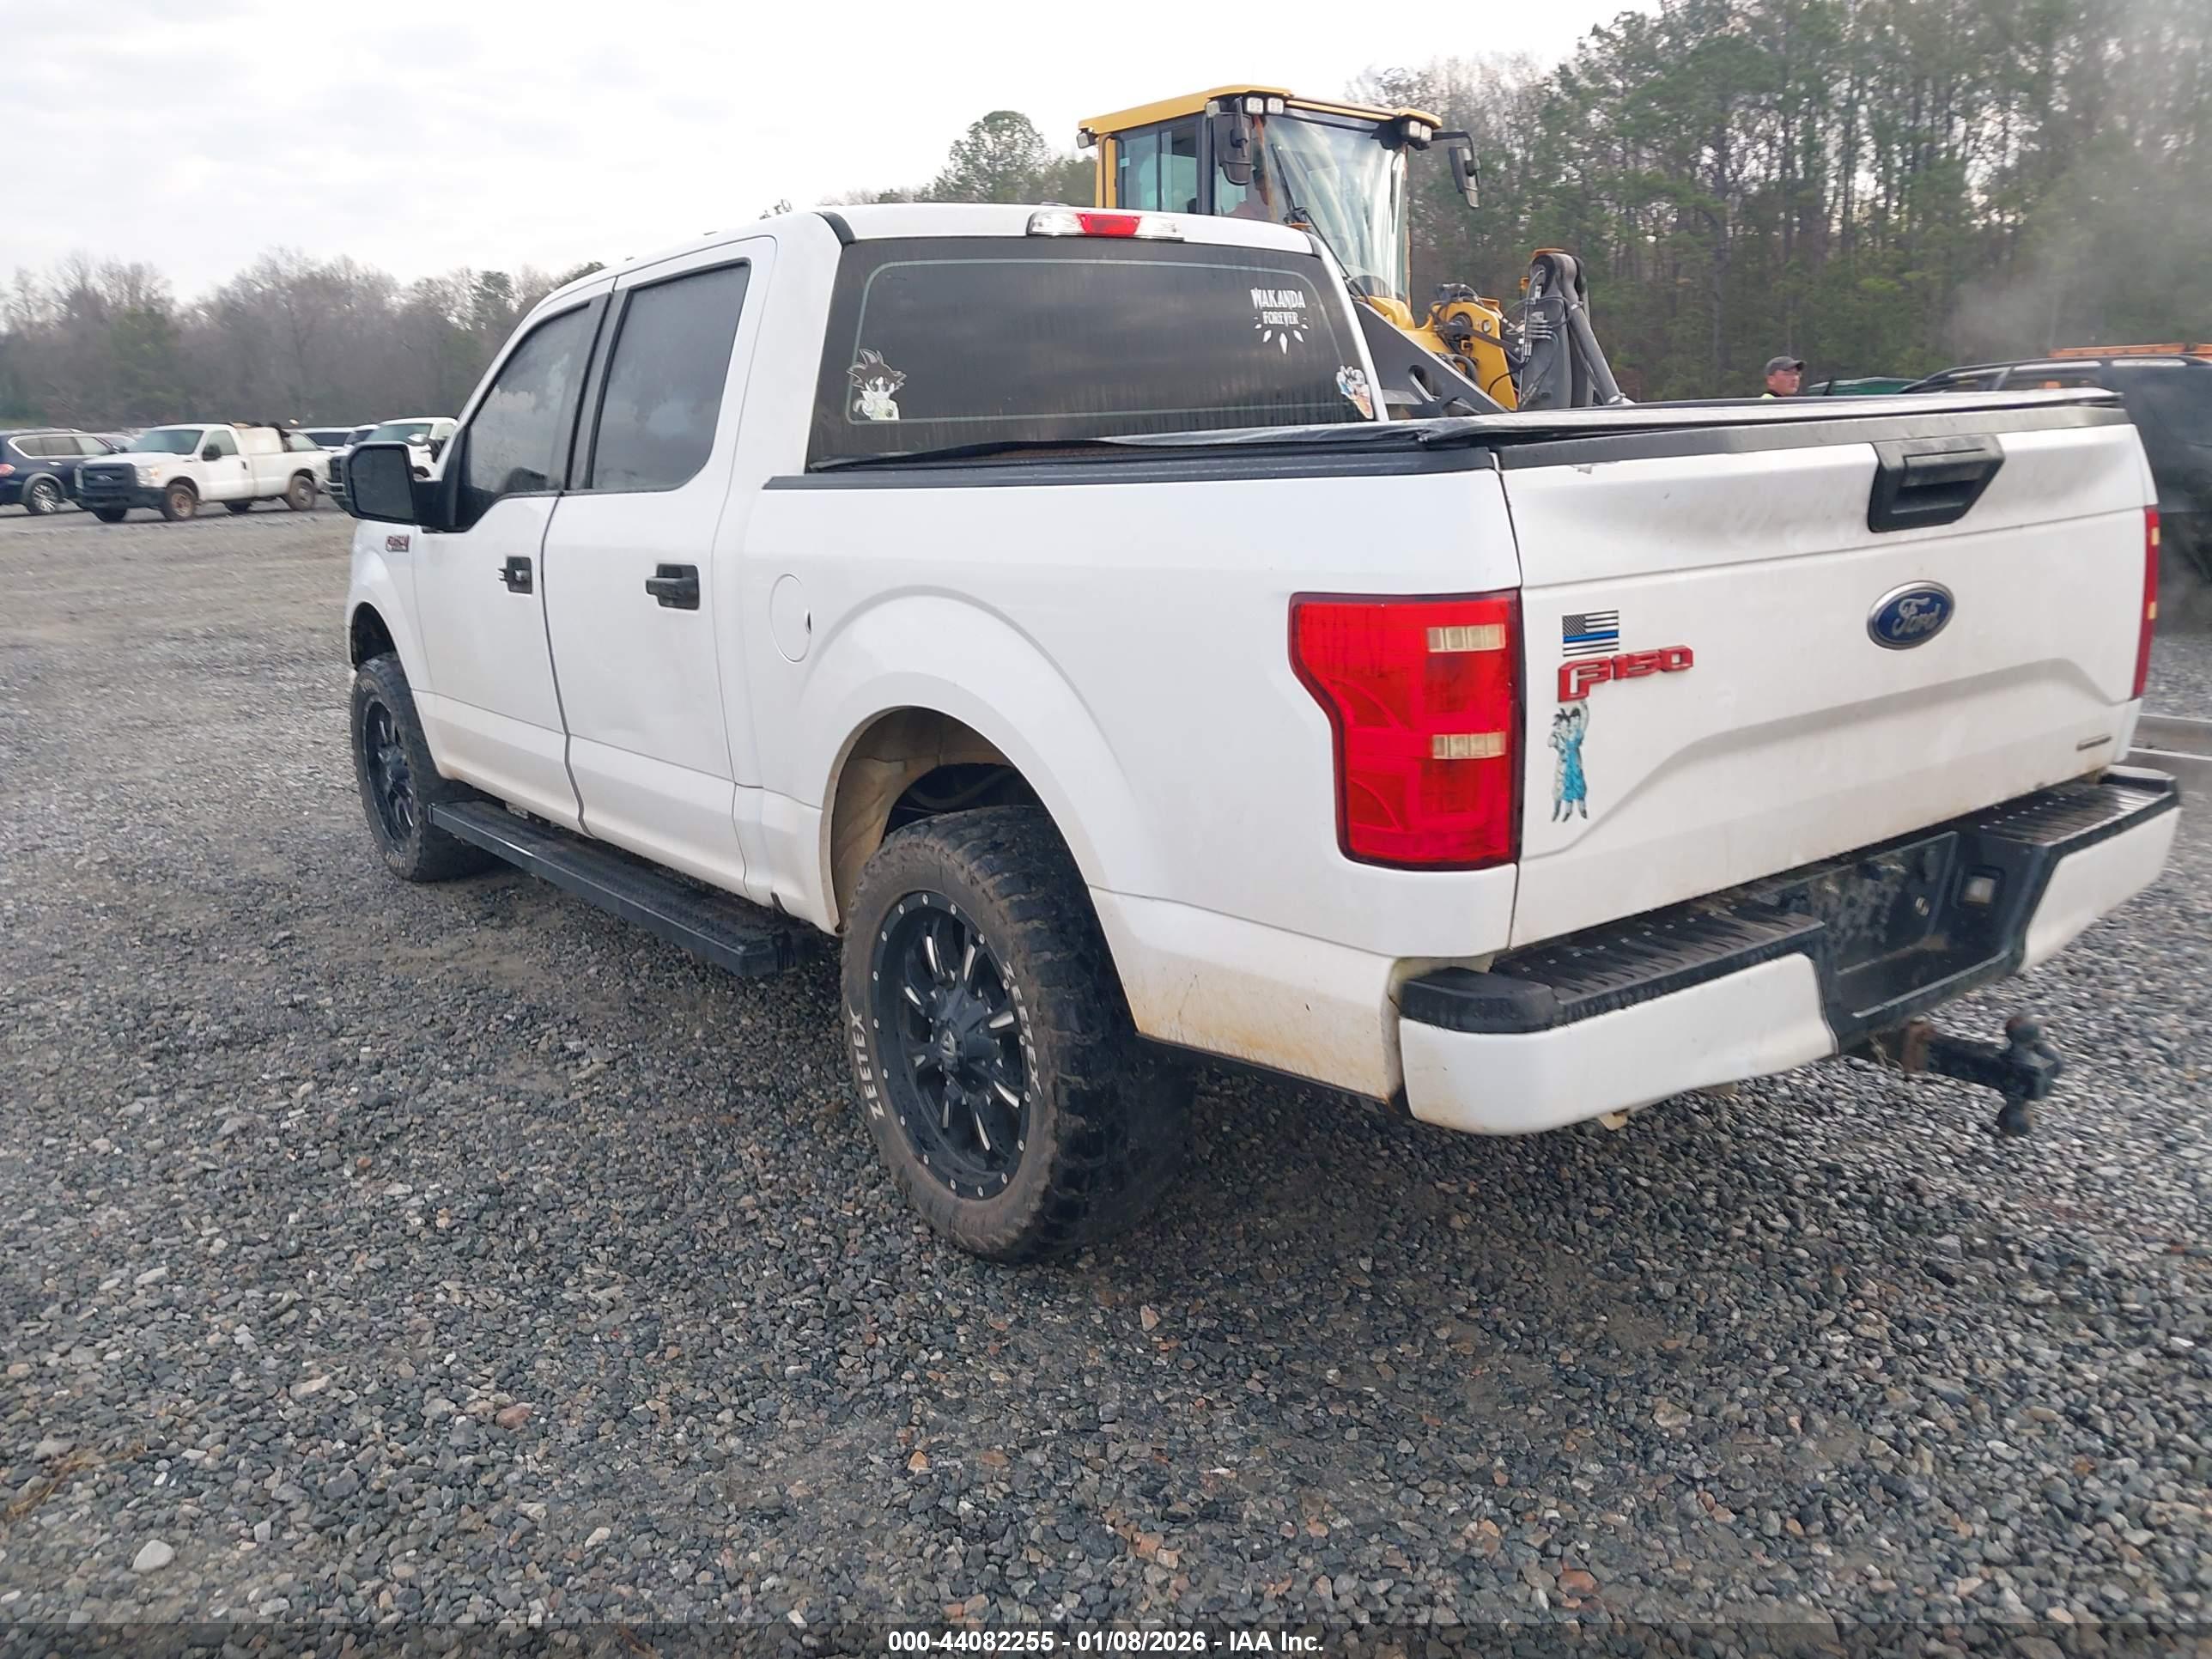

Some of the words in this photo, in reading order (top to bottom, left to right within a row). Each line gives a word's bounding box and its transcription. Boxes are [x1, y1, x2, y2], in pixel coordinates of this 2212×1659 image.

[1250, 287, 1306, 310] WAKANDA
[1262, 311, 1299, 326] FOREVER
[1892, 597, 1942, 636] Ford
[1002, 961, 1043, 1097] ZEETEX
[847, 1002, 885, 1120] ZEETEX
